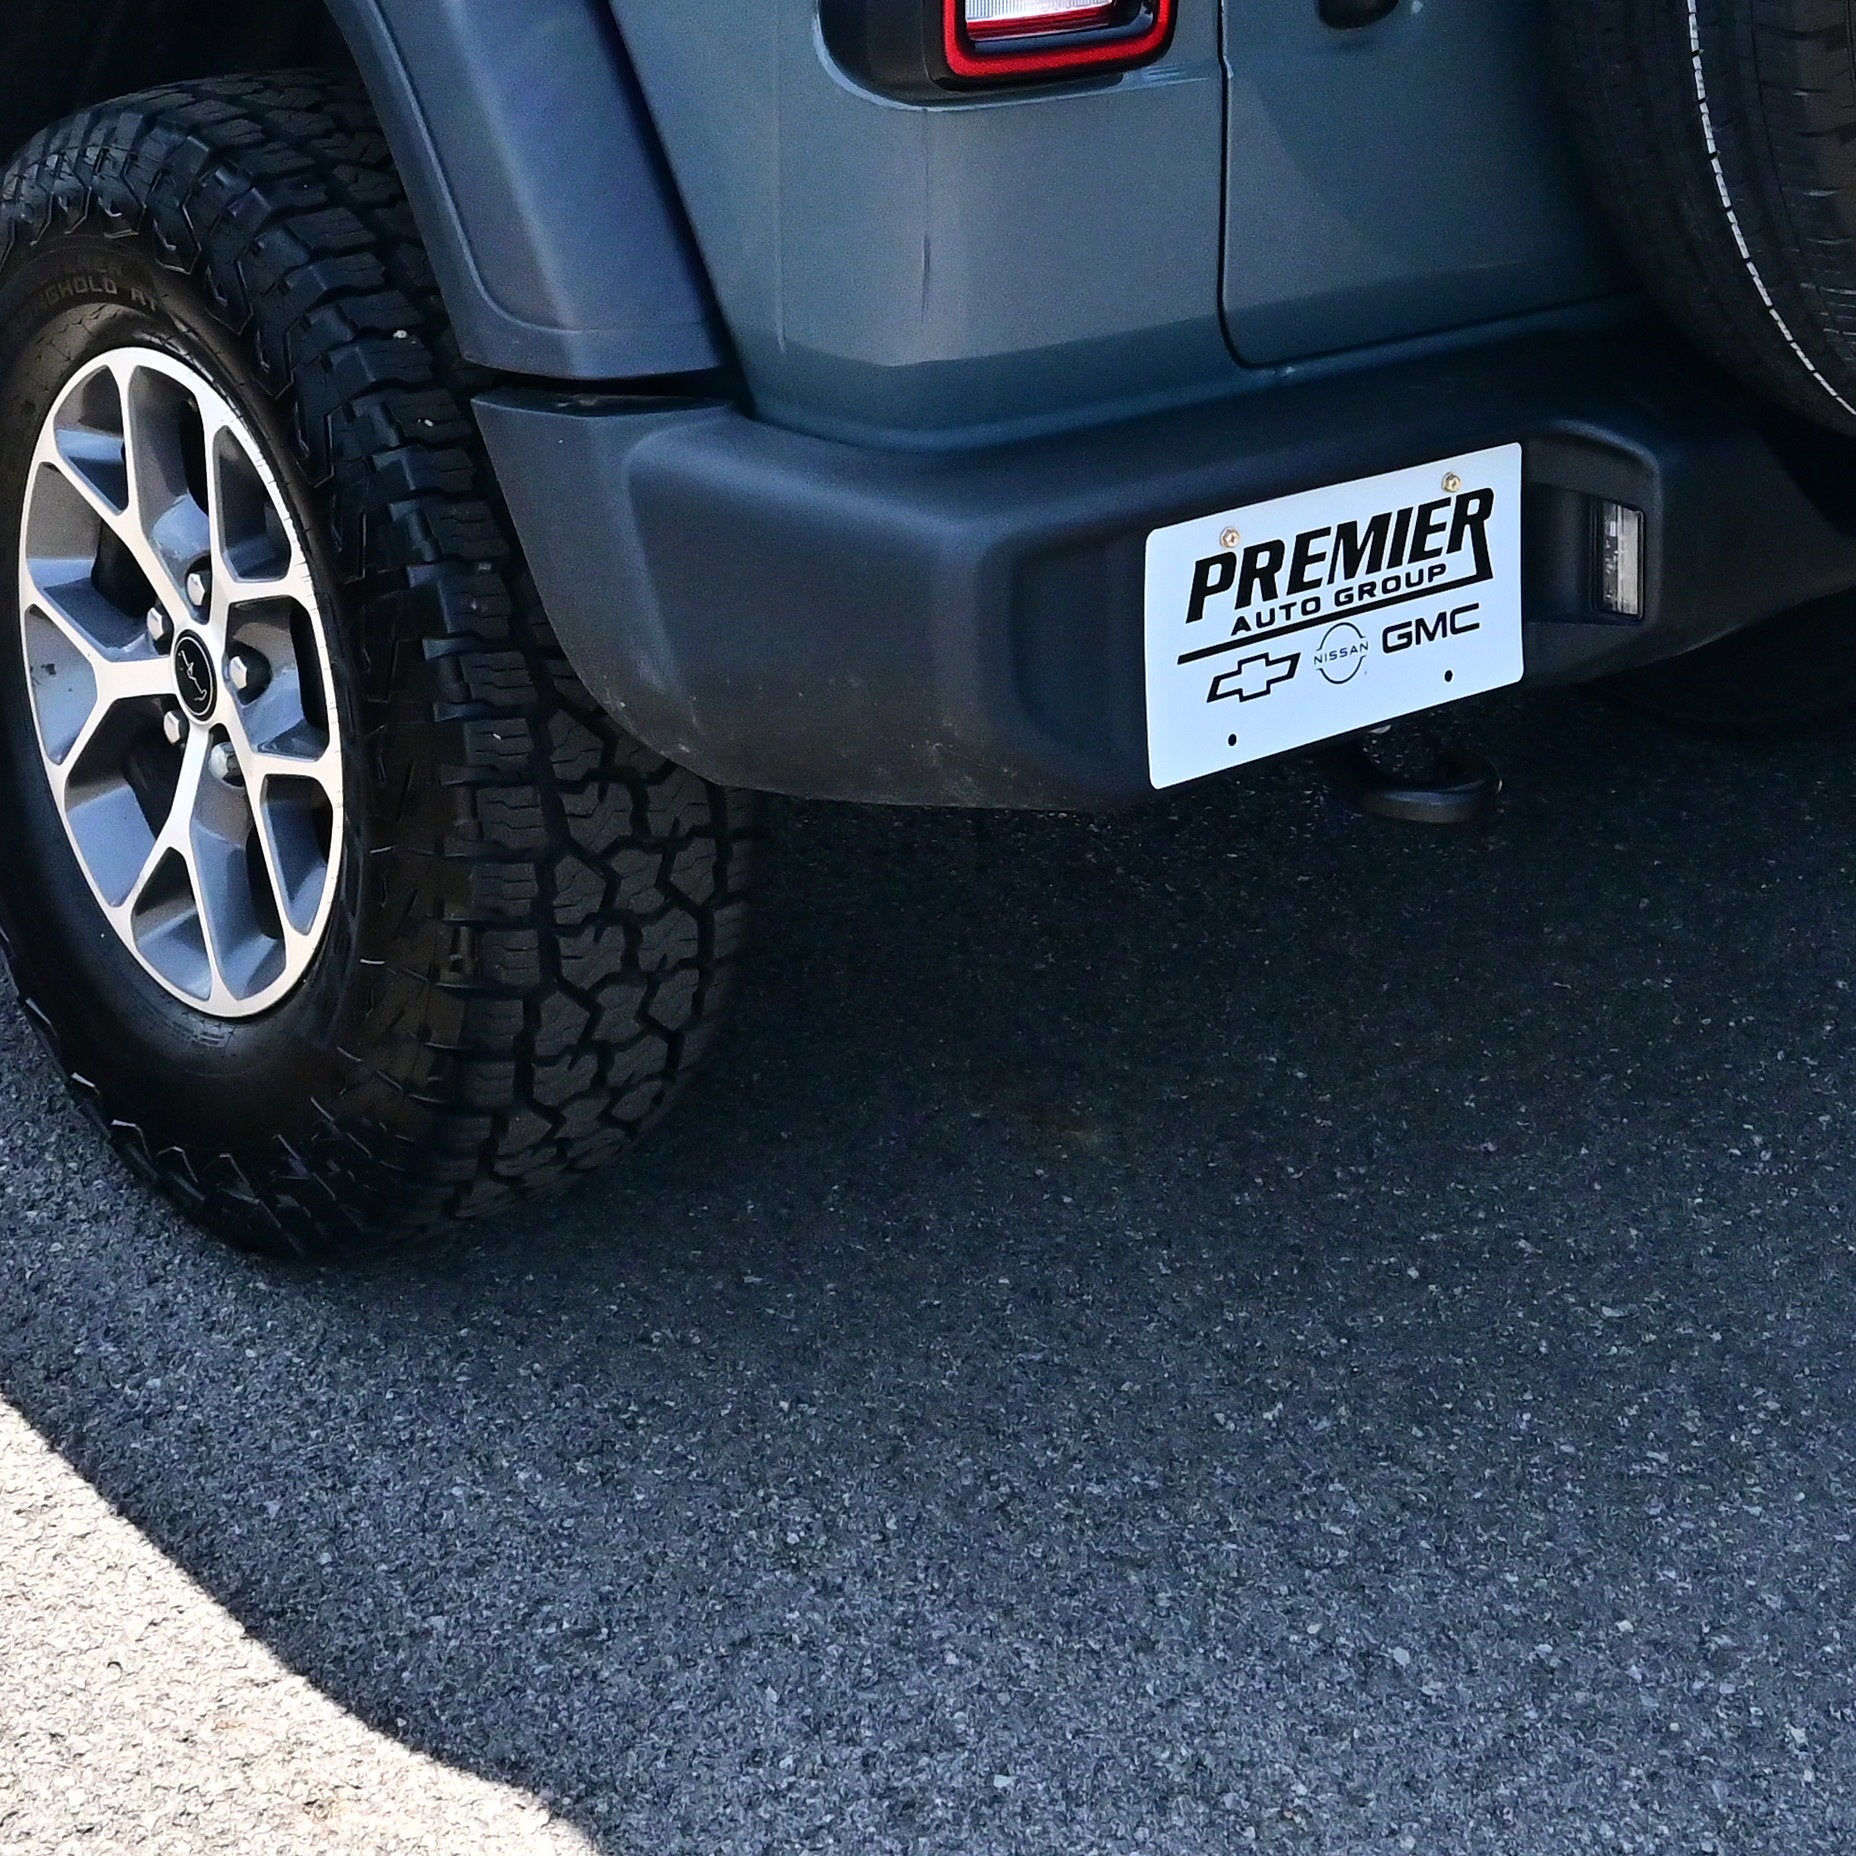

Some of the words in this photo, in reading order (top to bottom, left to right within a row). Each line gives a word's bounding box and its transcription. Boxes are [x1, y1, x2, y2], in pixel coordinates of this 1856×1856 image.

[1185, 488, 1495, 624] PREMIER
[1230, 596, 1322, 635] AUTO
[1334, 563, 1448, 608] GROUP
[1382, 602, 1481, 654] GMC
[1313, 639, 1370, 666] NISSAN
